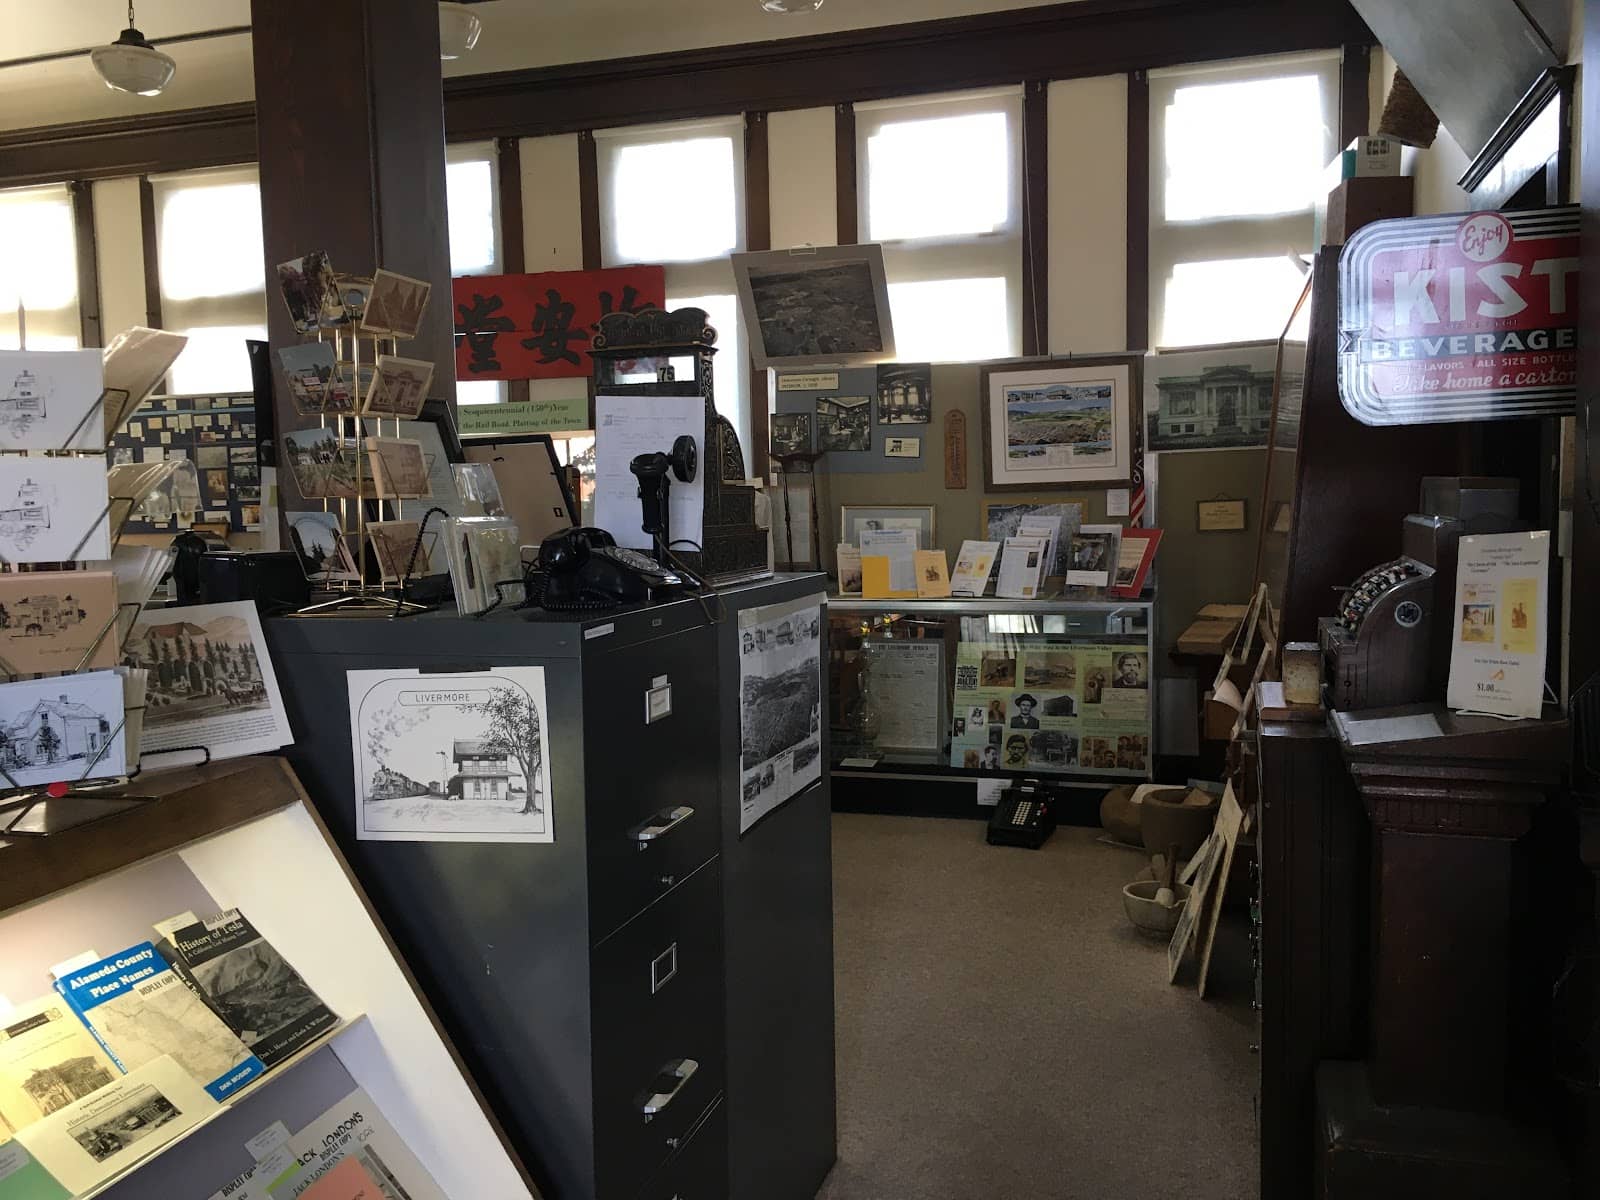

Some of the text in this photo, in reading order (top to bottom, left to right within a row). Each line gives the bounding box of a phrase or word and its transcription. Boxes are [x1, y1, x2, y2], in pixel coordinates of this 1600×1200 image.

[1462, 223, 1504, 256] Enjoy
[1393, 258, 1580, 326] KIST
[1477, 359, 1496, 368] ALL
[1502, 357, 1526, 366] SIZE
[1443, 371, 1493, 389] home
[1499, 375, 1512, 386] a
[415, 693, 471, 703] LIVERMORE
[180, 920, 244, 952] History of Tesla
[69, 960, 117, 990] Alameda
[116, 948, 154, 971] County
[90, 978, 121, 999] Place
[120, 966, 155, 990] Names
[322, 1111, 364, 1148] LONDON'S
[319, 1143, 341, 1160] DISPLAY
[221, 1177, 244, 1198] DISPLAY
